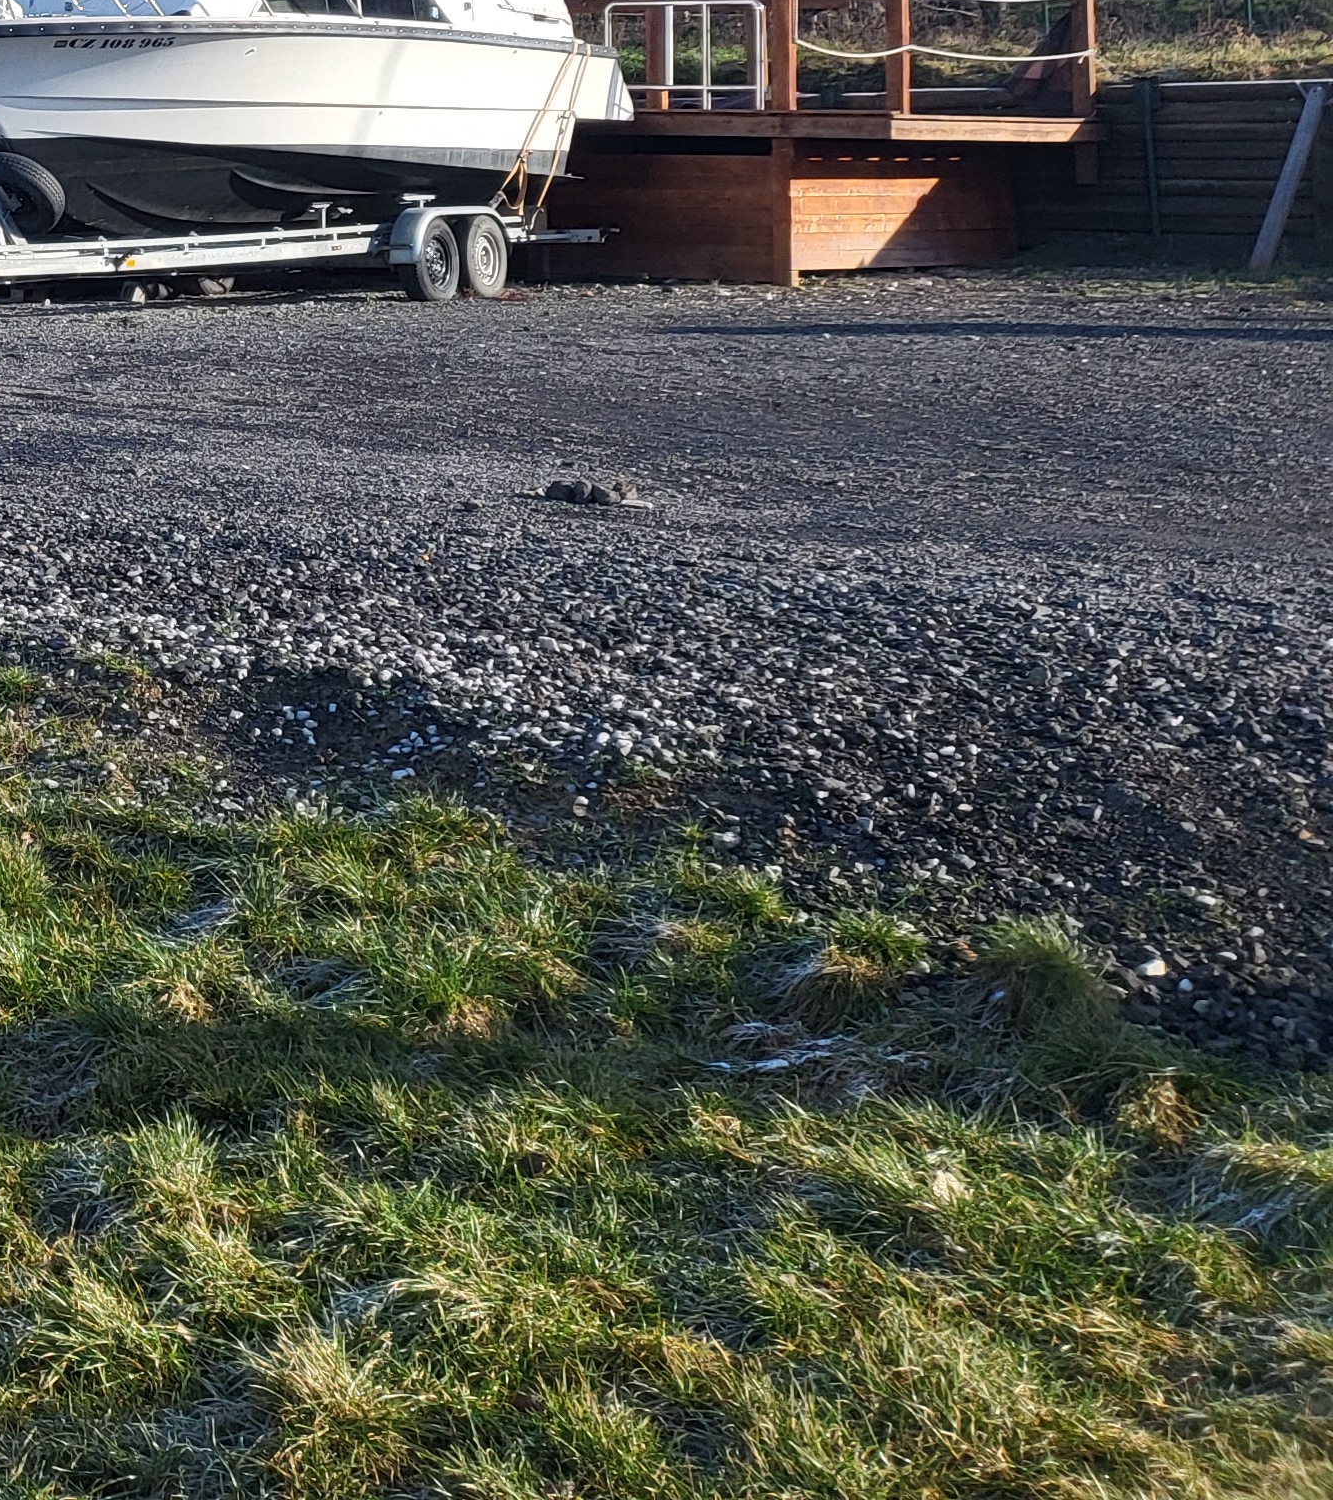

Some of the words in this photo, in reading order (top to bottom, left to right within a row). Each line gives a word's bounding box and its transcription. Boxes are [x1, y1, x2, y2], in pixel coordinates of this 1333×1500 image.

[68, 38, 98, 49] CZ
[99, 37, 136, 49] 108
[138, 36, 177, 48] 965
